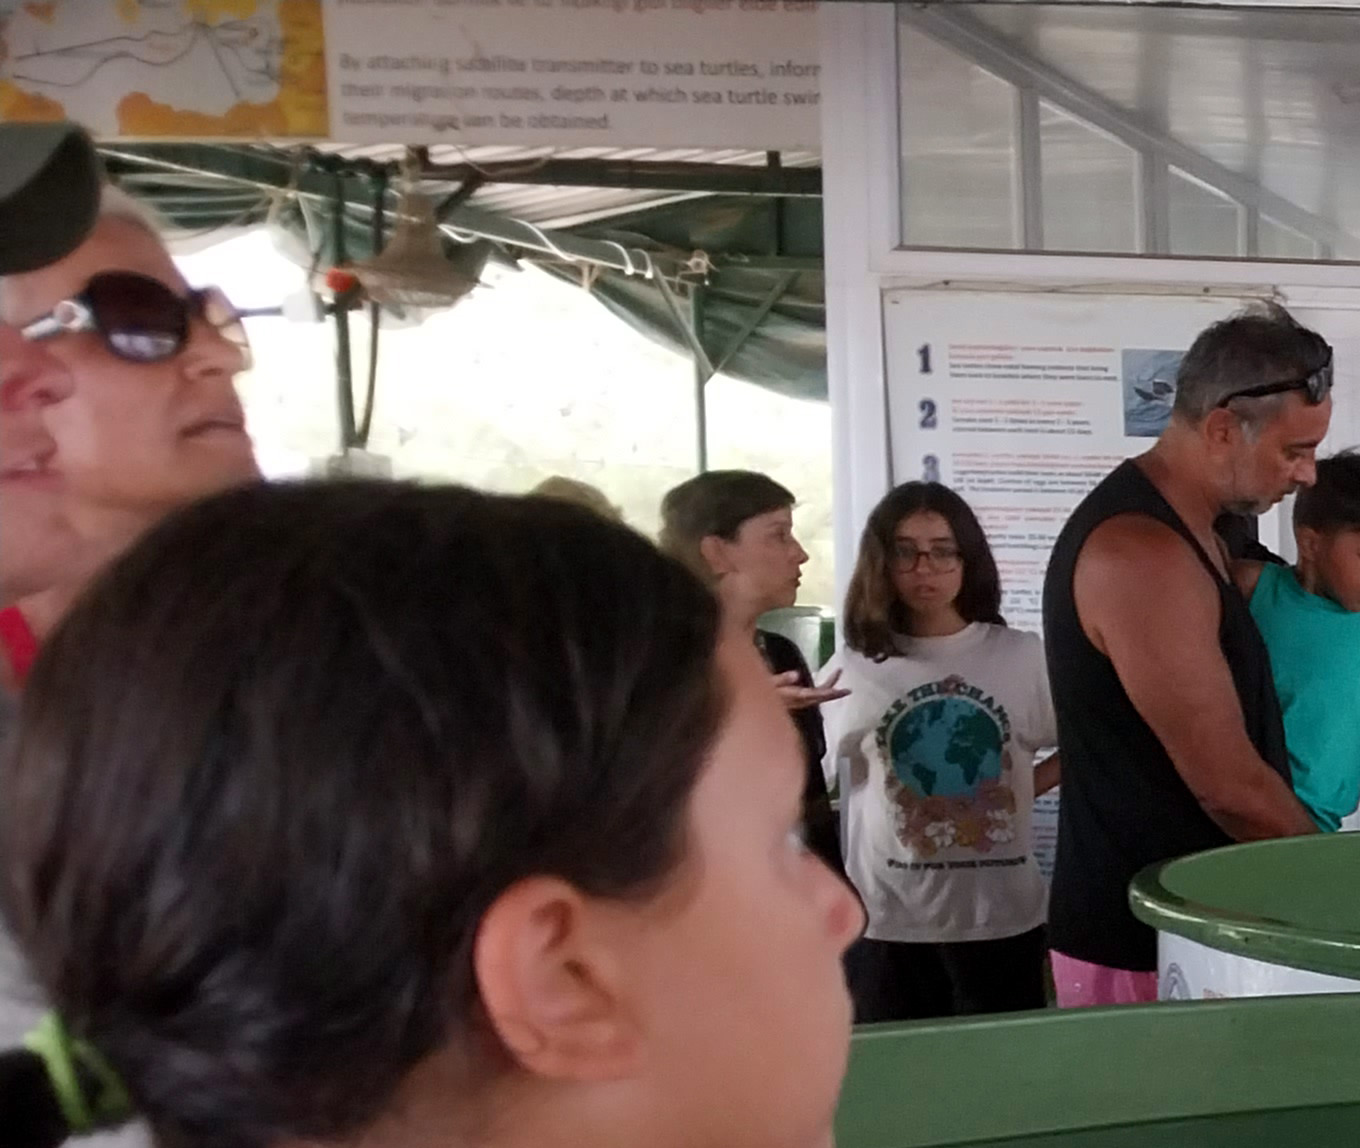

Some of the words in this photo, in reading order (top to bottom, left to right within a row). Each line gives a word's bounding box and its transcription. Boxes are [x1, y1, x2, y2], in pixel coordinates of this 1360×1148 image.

[639, 60, 659, 75] to
[663, 61, 695, 76] sea
[633, 86, 688, 104] which
[692, 91, 723, 105] sea
[727, 89, 778, 105] turtle
[917, 343, 932, 375] 1
[918, 399, 937, 429] 2
[922, 454, 940, 484] 3
